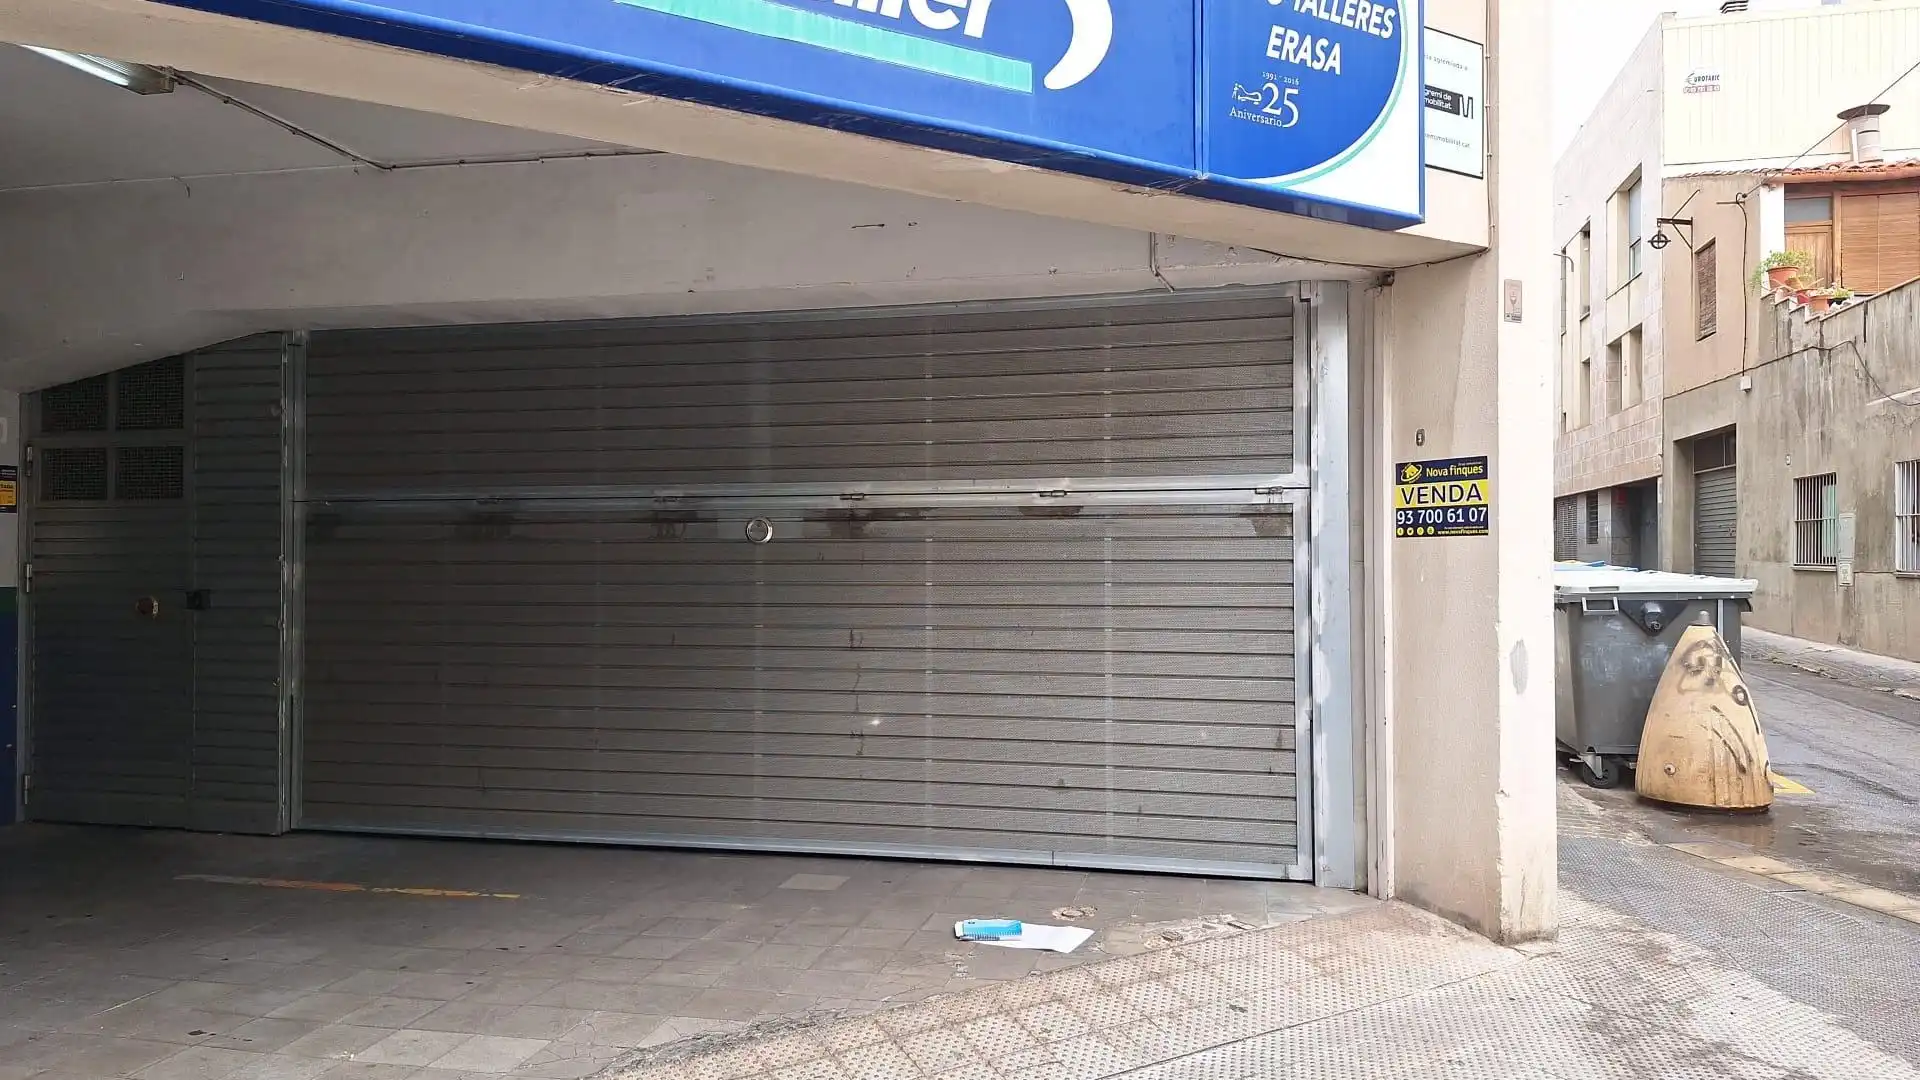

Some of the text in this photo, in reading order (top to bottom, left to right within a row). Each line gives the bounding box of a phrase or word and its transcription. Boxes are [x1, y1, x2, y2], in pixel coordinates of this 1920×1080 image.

[1266, 24, 1341, 75] ERASA
[1262, 71, 1277, 80] 1991
[1262, 82, 1299, 128] 25
[1443, 93, 1452, 101] de
[1229, 106, 1282, 127] Aniversario
[1426, 464, 1484, 477] Nova finques
[1401, 483, 1482, 504] VENDA
[1397, 507, 1487, 524] 93 700 61 07
